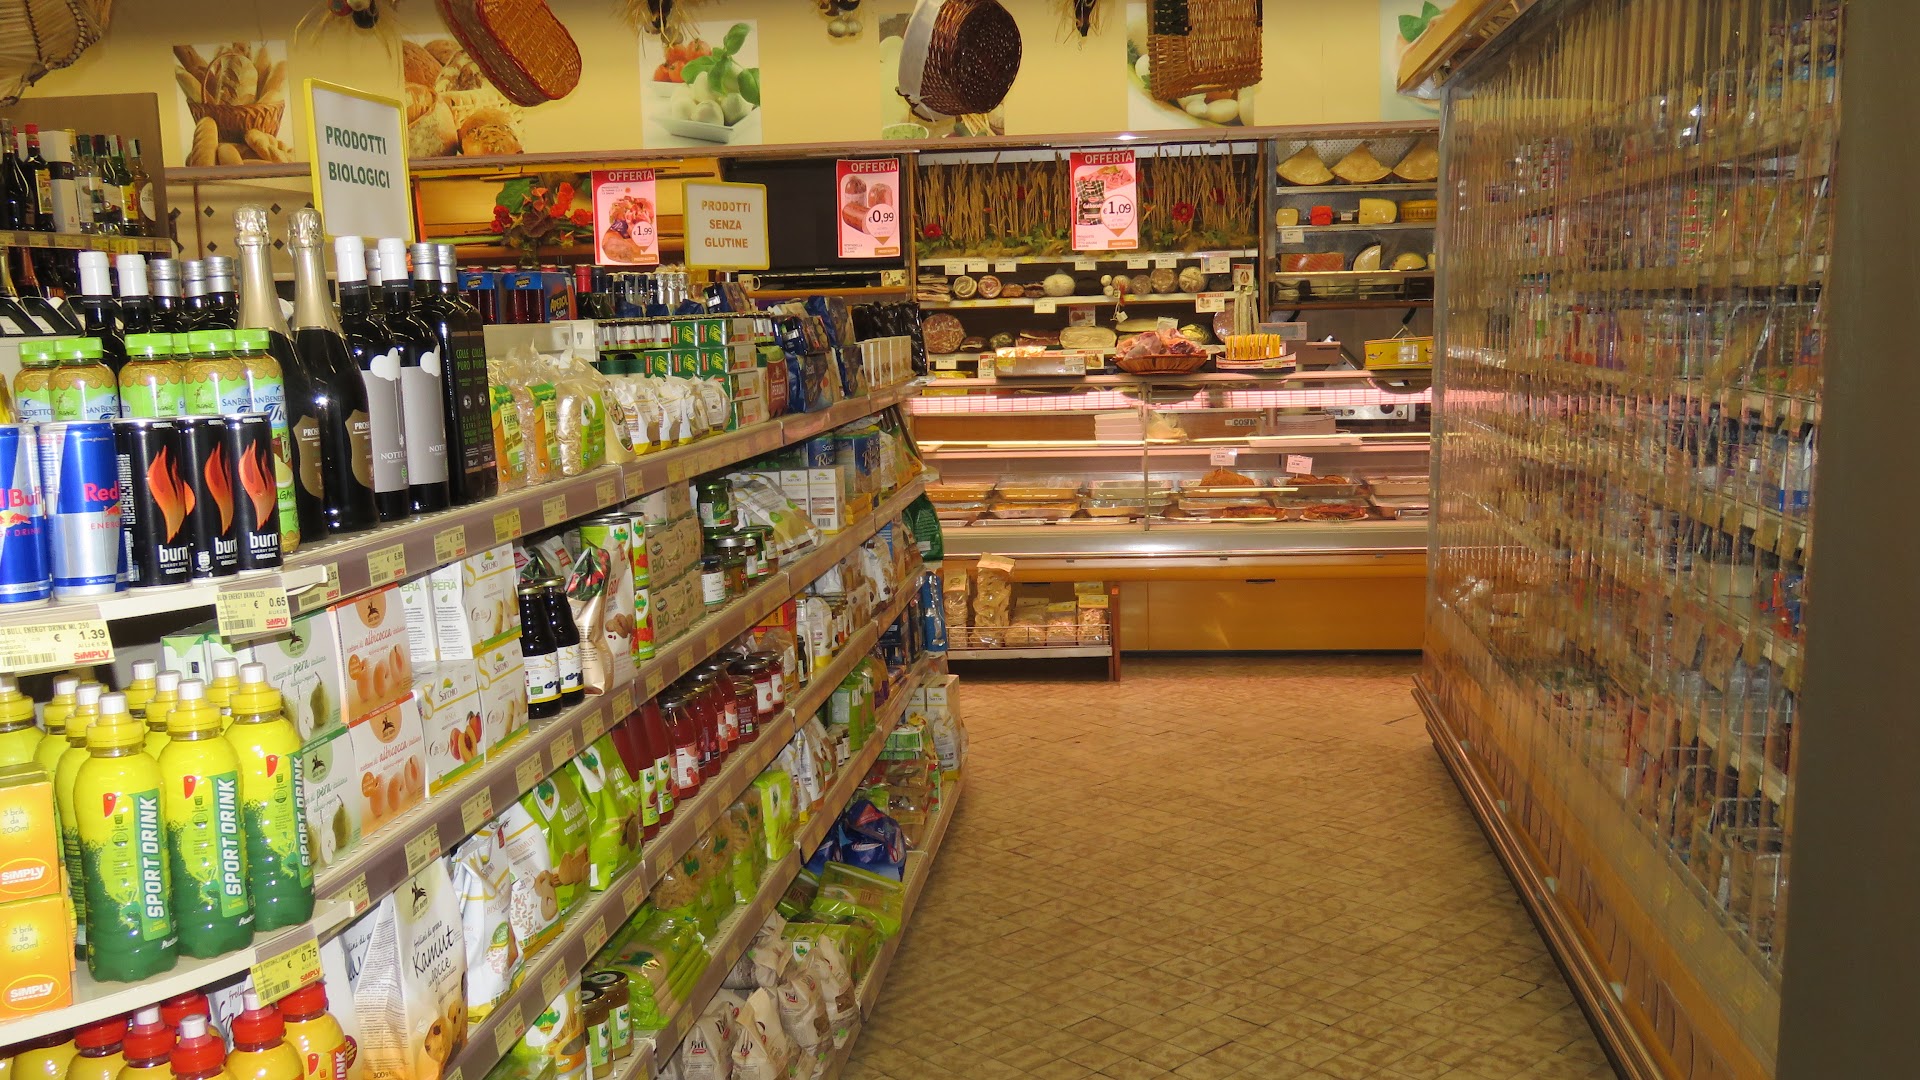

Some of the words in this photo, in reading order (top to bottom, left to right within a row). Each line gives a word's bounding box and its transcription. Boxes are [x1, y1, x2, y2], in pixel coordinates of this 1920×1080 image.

[325, 125, 387, 155] PRODOTTI
[1084, 152, 1133, 164] OFFERTA
[851, 161, 897, 173] OFFERTA
[328, 161, 391, 189] BIOLOGICI
[608, 170, 653, 182] OFFERTA
[701, 200, 751, 213] PRODOTTI
[709, 219, 743, 231] SENZA
[704, 237, 749, 249] GLUTINE
[83, 482, 120, 502] Red
[249, 532, 278, 549] burn
[158, 545, 188, 563] burn
[401, 582, 421, 592] ERA
[432, 581, 457, 591] PERA
[254, 600, 259, 609] €
[269, 597, 287, 607] 0.65
[24, 626, 46, 634] ENERGY
[54, 634, 62, 642] €
[79, 628, 106, 640] 1.39
[293, 756, 304, 813] DRINK
[10, 807, 25, 816] brik
[217, 778, 238, 835] DRINK
[10, 816, 20, 825] da
[139, 796, 160, 854] DRINK
[2, 824, 30, 834] 200ml
[296, 811, 312, 867] SPORT
[221, 836, 242, 897] SPORT
[142, 856, 165, 919] SPORT
[19, 925, 34, 933] brik
[19, 934, 29, 943] da
[11, 941, 39, 952] 200ml
[412, 925, 454, 979] Kamut
[301, 947, 317, 962] 0.75
[335, 1051, 347, 1080] INK
